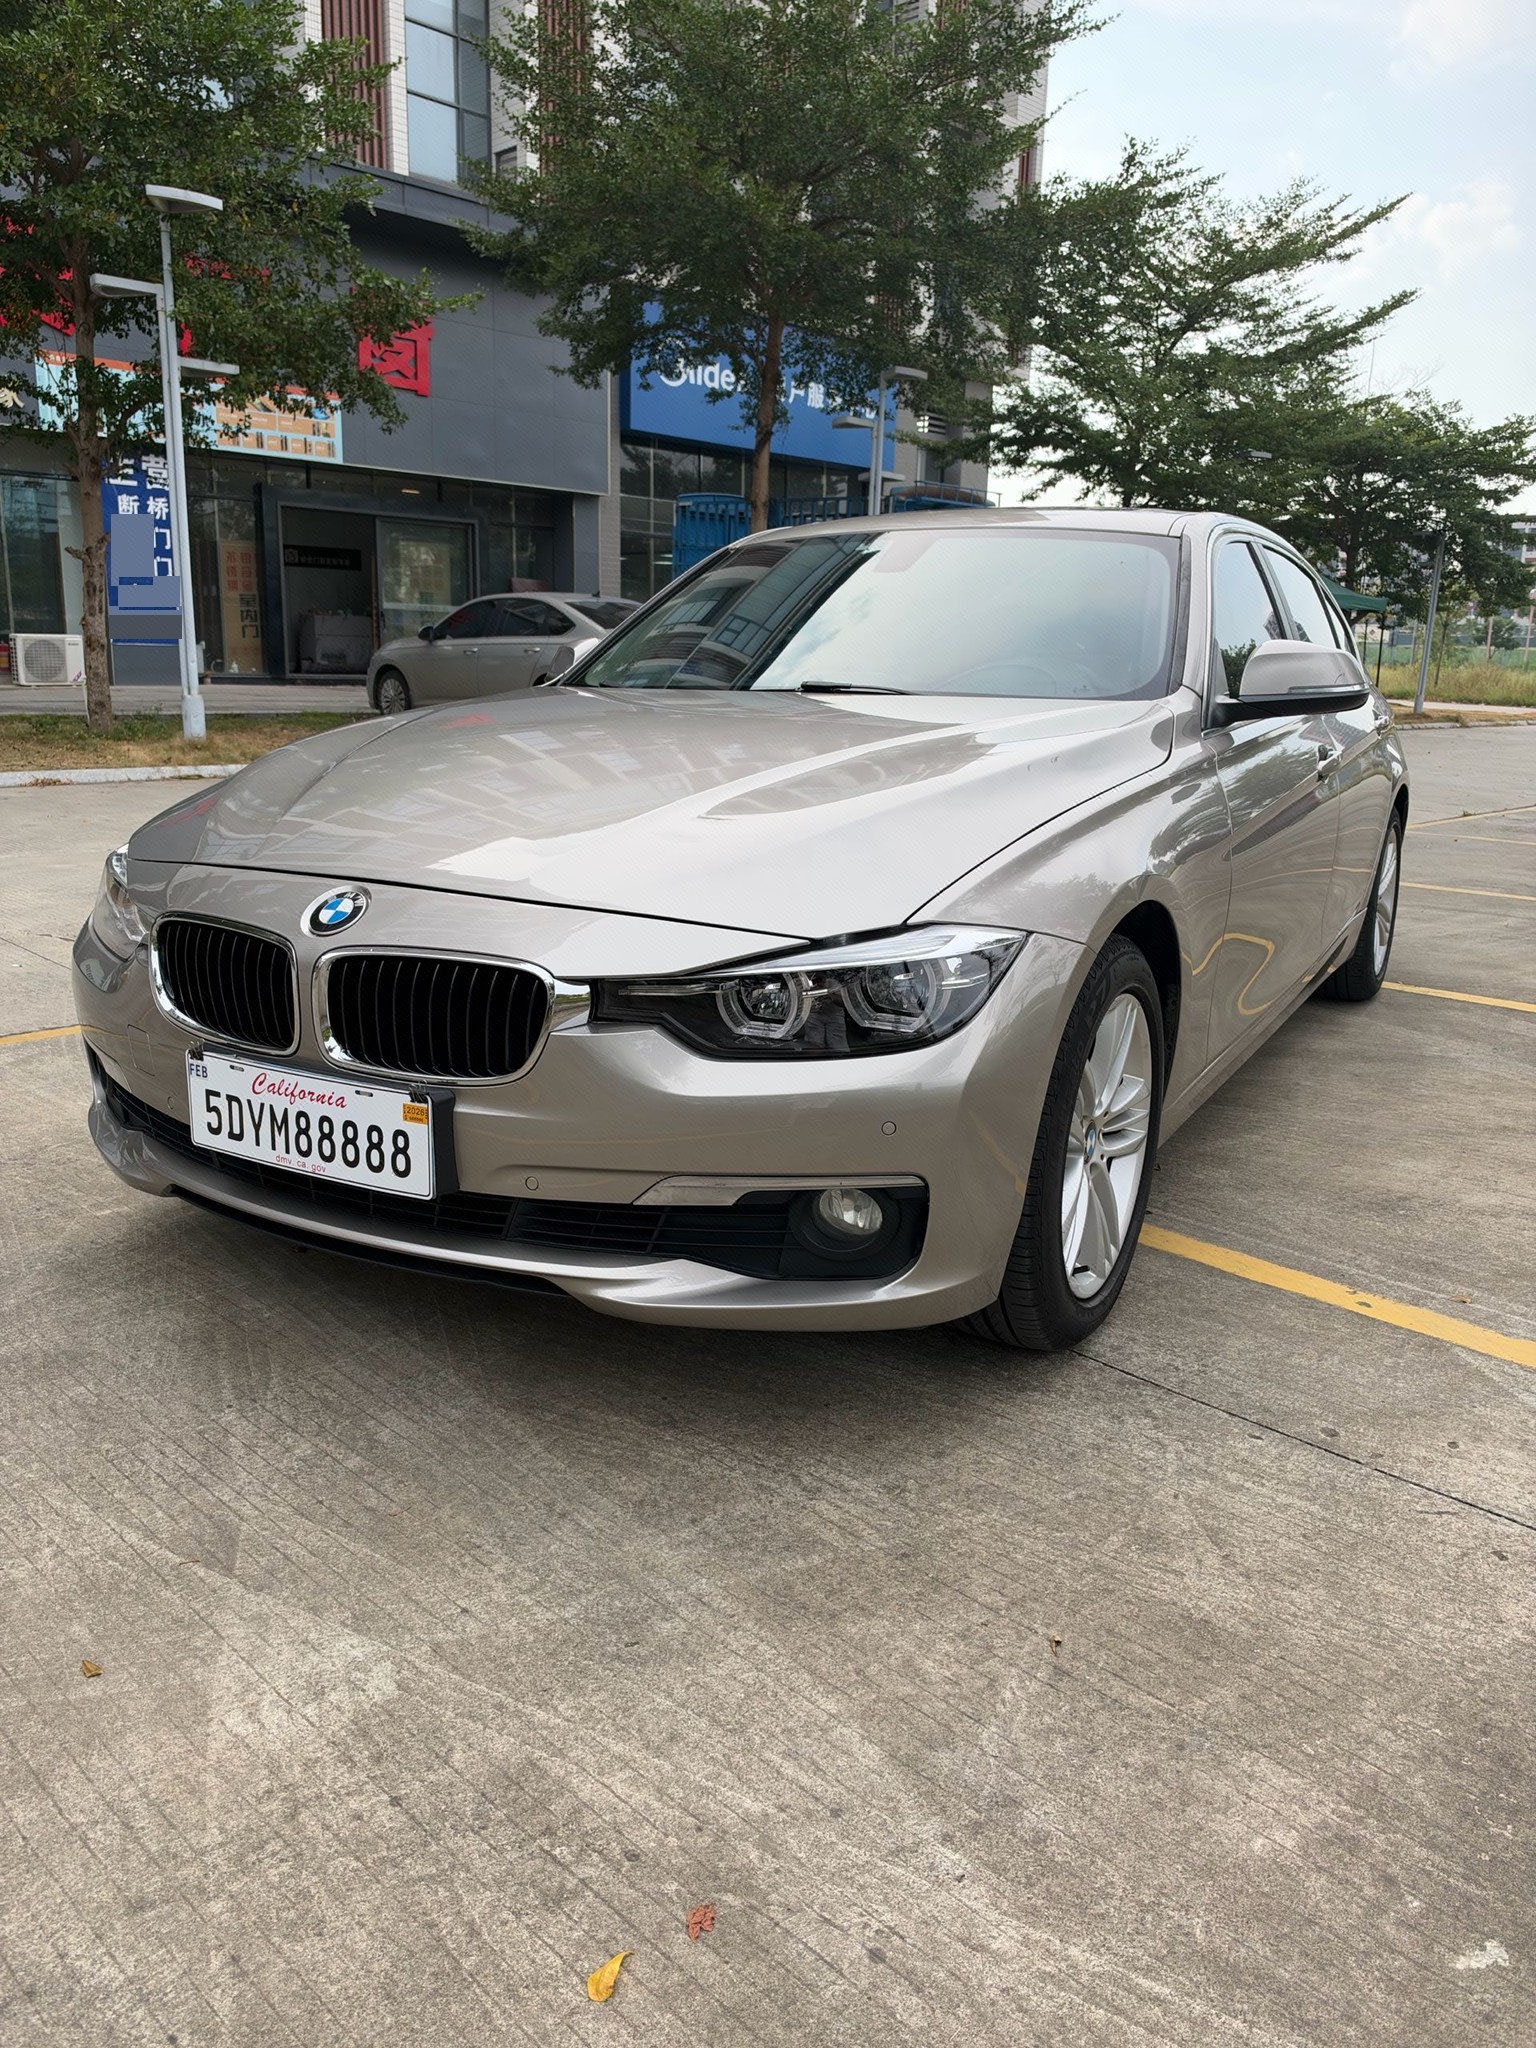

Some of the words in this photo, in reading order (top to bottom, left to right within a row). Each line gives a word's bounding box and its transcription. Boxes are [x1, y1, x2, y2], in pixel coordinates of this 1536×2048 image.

[190, 1063, 208, 1079] FEB
[251, 1072, 347, 1109] California
[205, 1088, 412, 1179] 5DYM88888
